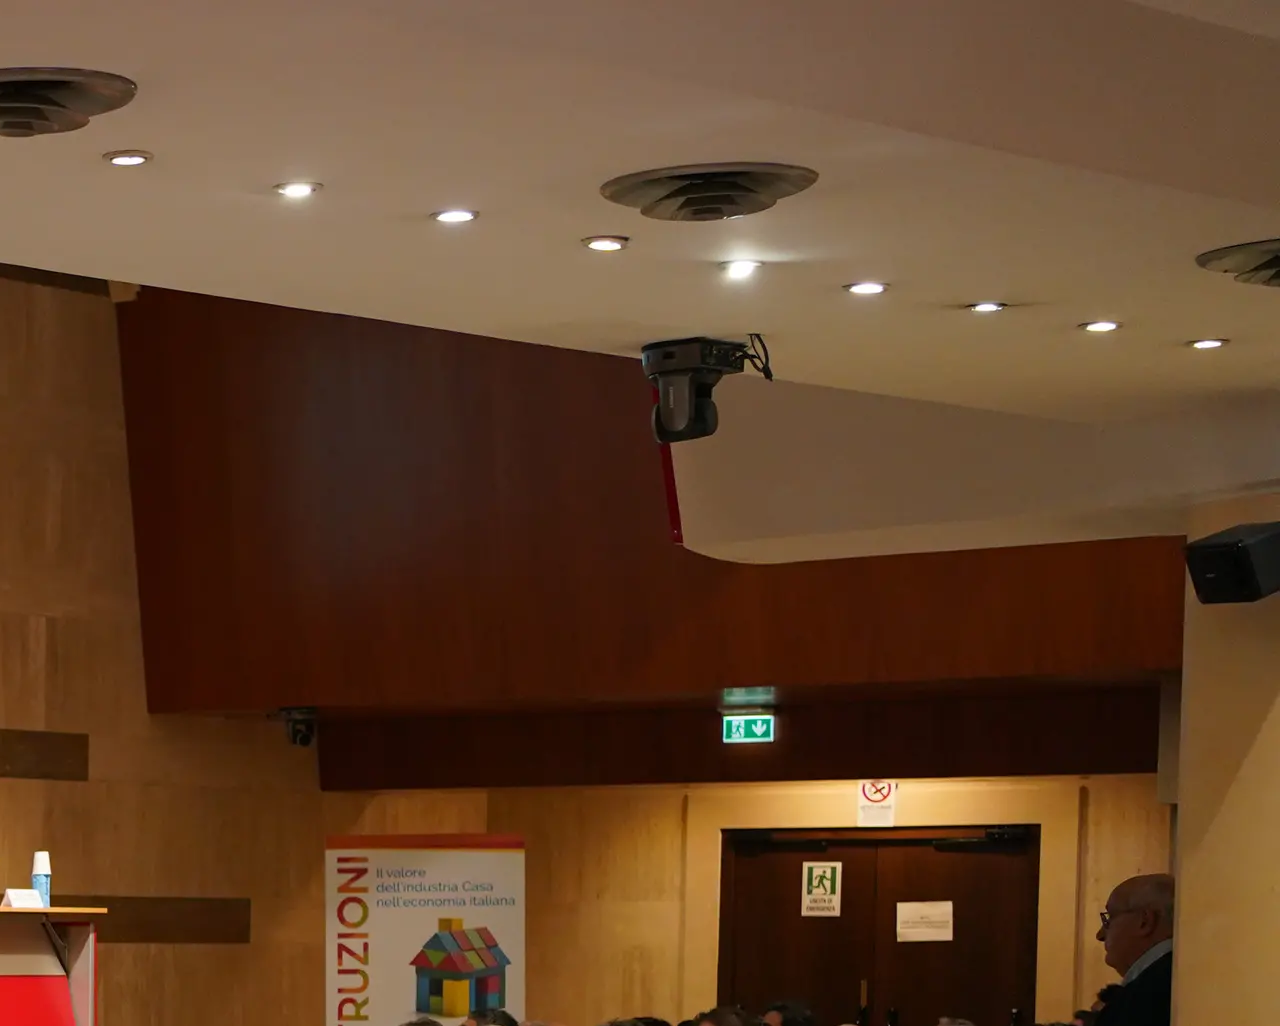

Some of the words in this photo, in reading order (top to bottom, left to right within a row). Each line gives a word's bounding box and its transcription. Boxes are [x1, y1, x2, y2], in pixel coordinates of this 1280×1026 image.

[376, 868, 383, 878] Il
[388, 868, 426, 878] valore
[376, 881, 458, 893] dell'industria
[462, 881, 493, 892] Casa
[376, 896, 466, 907] nell'economia
[470, 895, 515, 906] italiana
